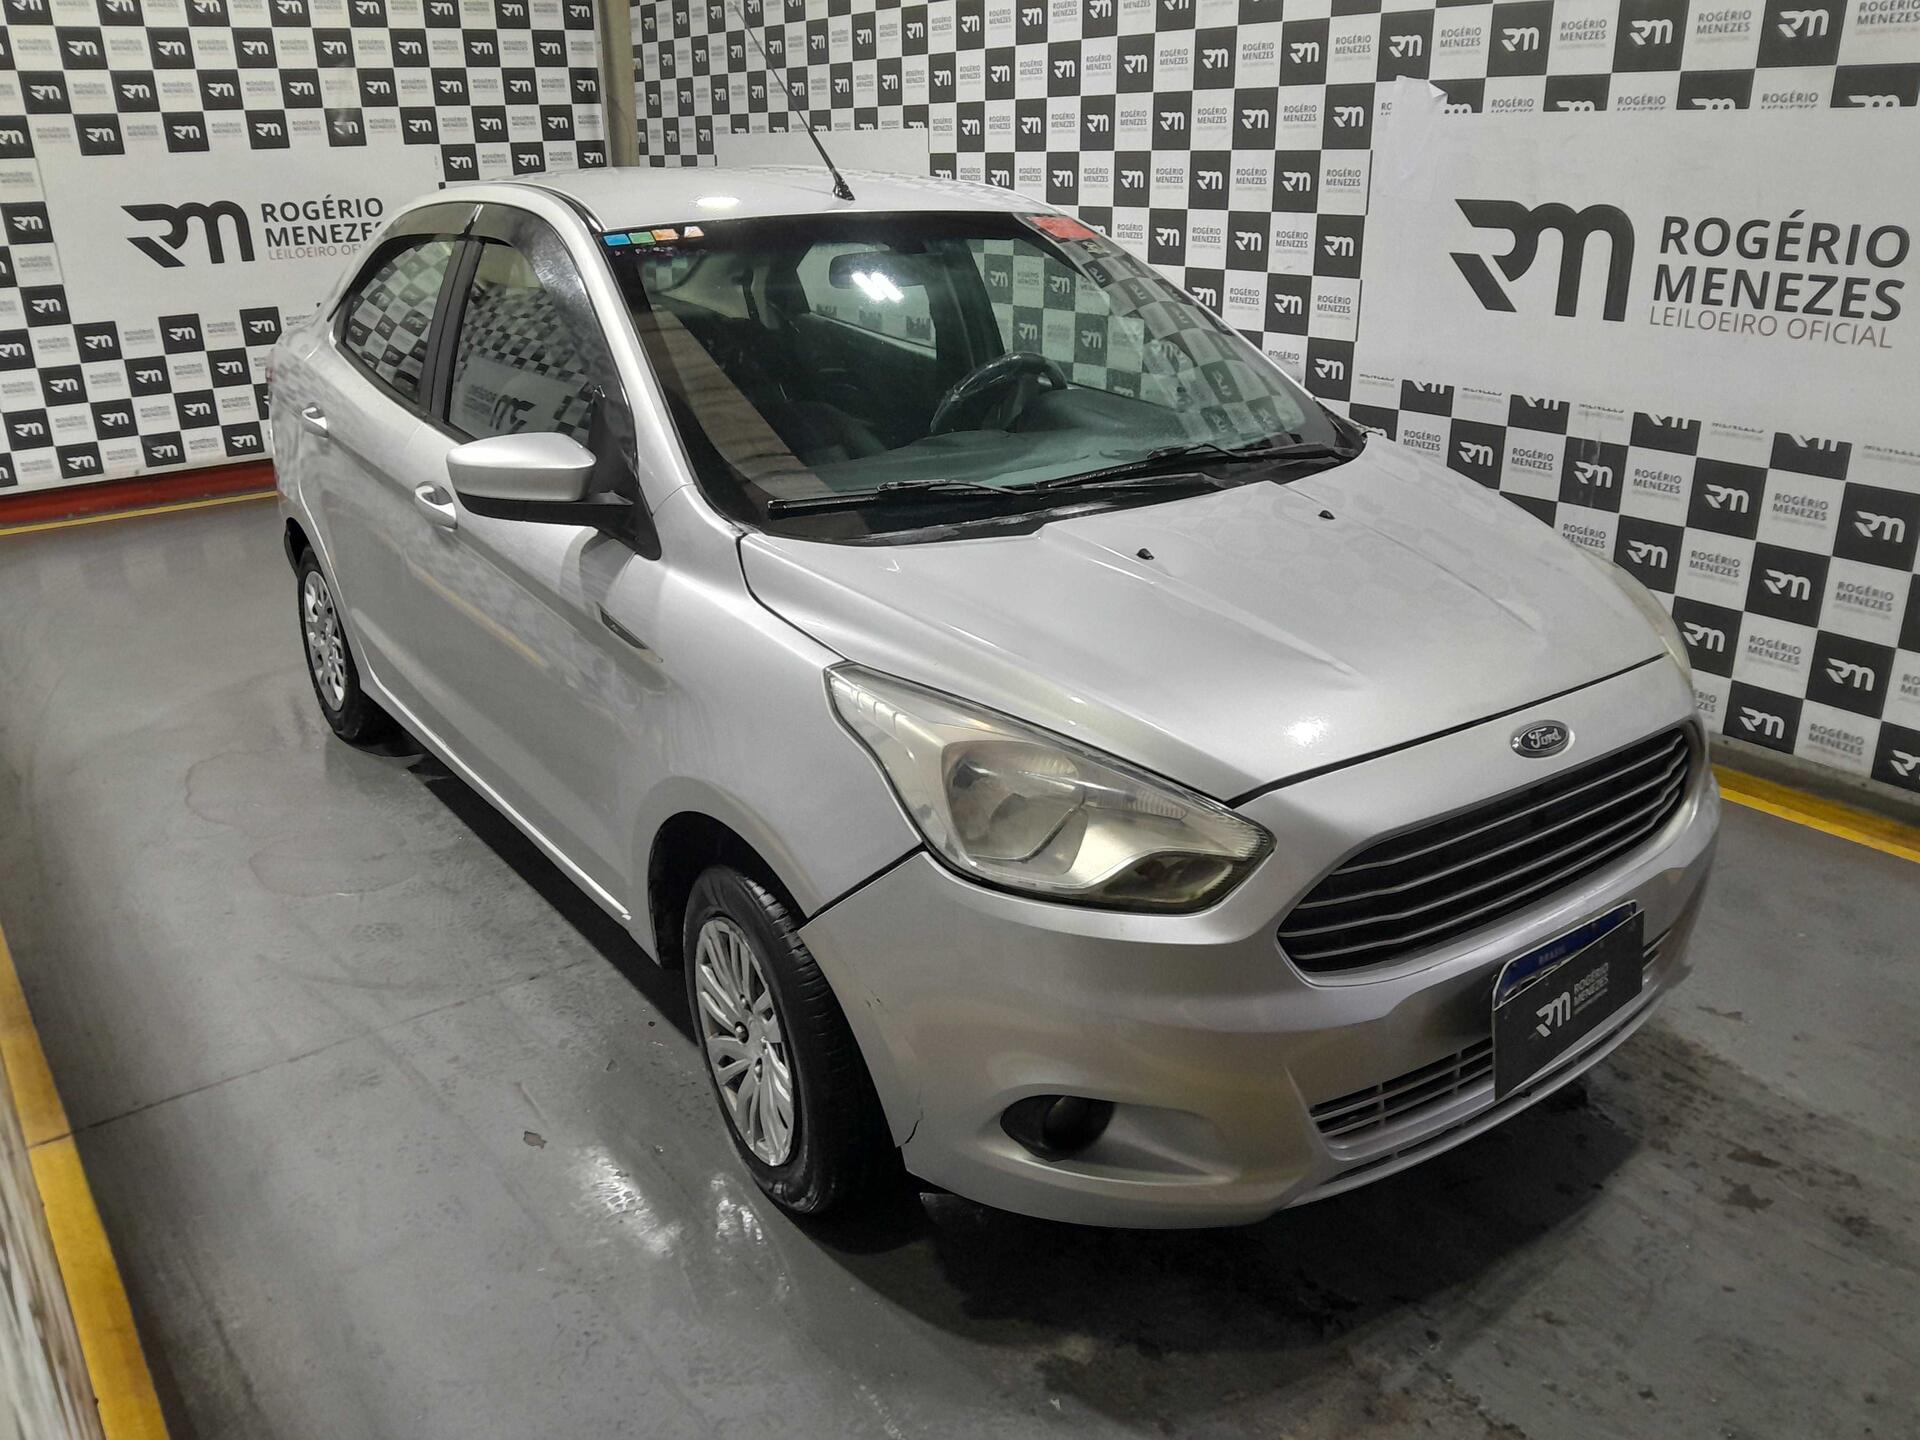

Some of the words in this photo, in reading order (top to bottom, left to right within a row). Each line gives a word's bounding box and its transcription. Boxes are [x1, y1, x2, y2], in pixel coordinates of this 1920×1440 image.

[1698, 10, 1751, 22] ROGÉRIO
[1857, 11, 1920, 24] MENEZES
[1561, 18, 1607, 30] ROGÉRIO
[1696, 22, 1750, 36] MENEZES
[1441, 26, 1481, 38] ROGÉRIO
[1560, 30, 1606, 41] MENEZES
[1336, 34, 1371, 45] ROGÉRIO
[1440, 37, 1480, 47] MENEZES
[1243, 41, 1274, 52] ROGÉRIO
[1335, 44, 1371, 54] MENEZES
[1242, 51, 1274, 60] MENEZES
[1491, 97, 1534, 108] ROGÉRIO
[1618, 94, 1666, 105] ROGÉRIO
[1762, 91, 1818, 103] ROGÉRIO
[1284, 103, 1317, 113] ROGÉRIO
[1283, 114, 1316, 122] MENEZES
[1236, 167, 1267, 176] ROGÉRIO
[1326, 168, 1361, 178] ROGÉRIO
[1236, 177, 1267, 185] MENEZES
[1326, 178, 1360, 186] MENEZES
[260, 194, 383, 223] ROGÉRIO
[265, 221, 382, 248] MENEZE
[1276, 230, 1308, 240] ROGÉRIO
[1660, 209, 1910, 268] ROGÉRIO
[1276, 239, 1308, 248] MENEZES
[269, 245, 337, 260] LEILOEIRO
[1654, 264, 1905, 321] MENEZES
[1317, 294, 1351, 305] ROGÉRIO
[1317, 304, 1351, 313] MENEZES
[1650, 306, 1777, 337] LEILOEIRO
[1787, 318, 1893, 349] OFICIAL
[1404, 429, 1441, 442] ROGÉRIO
[1403, 438, 1440, 451] MENEZES
[1512, 448, 1554, 462] ROGÉRIO
[1511, 457, 1553, 471] MENEZES
[1634, 469, 1681, 484] ROGÉRIO
[1633, 479, 1681, 494] MENEZES
[1775, 493, 1828, 510] ROGÉRIO
[1773, 504, 1827, 521] MENEZES
[1563, 524, 1606, 539] ROGÉRIO
[1562, 532, 1605, 549] MENEZES
[1691, 550, 1740, 567] ROGÉRIO
[1689, 560, 1739, 578] MENEZES
[1837, 582, 1894, 601] ROGÉRIO
[1835, 592, 1893, 612] MENEZES
[1750, 635, 1801, 655] ROGÉRIO
[1748, 646, 1800, 665] MENEZES
[1528, 727, 1561, 749] Ford
[1810, 723, 1864, 745] ROGÉRIO
[1808, 734, 1863, 755] MENEZES
